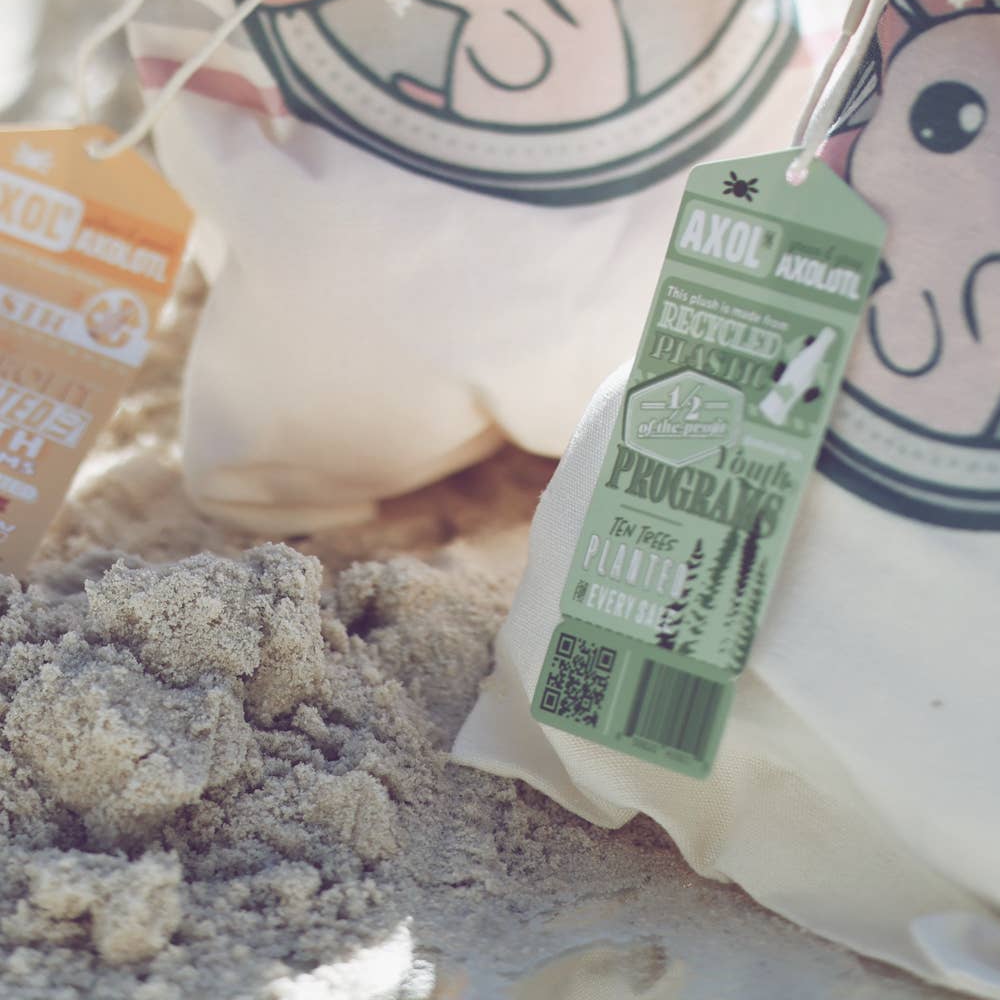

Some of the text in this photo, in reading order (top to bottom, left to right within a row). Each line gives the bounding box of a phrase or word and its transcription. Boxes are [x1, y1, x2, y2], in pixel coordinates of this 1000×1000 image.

[774, 252, 862, 300] AXOLOTL
[667, 286, 688, 302] This
[689, 294, 720, 312] plush
[657, 301, 783, 360] RECYCLED
[650, 332, 768, 391] PLASTIC
[638, 419, 657, 438] of
[657, 419, 679, 434] the
[609, 517, 679, 551] TEN TREES
[583, 534, 690, 600] PLANTED
[586, 583, 636, 620] EVERY
